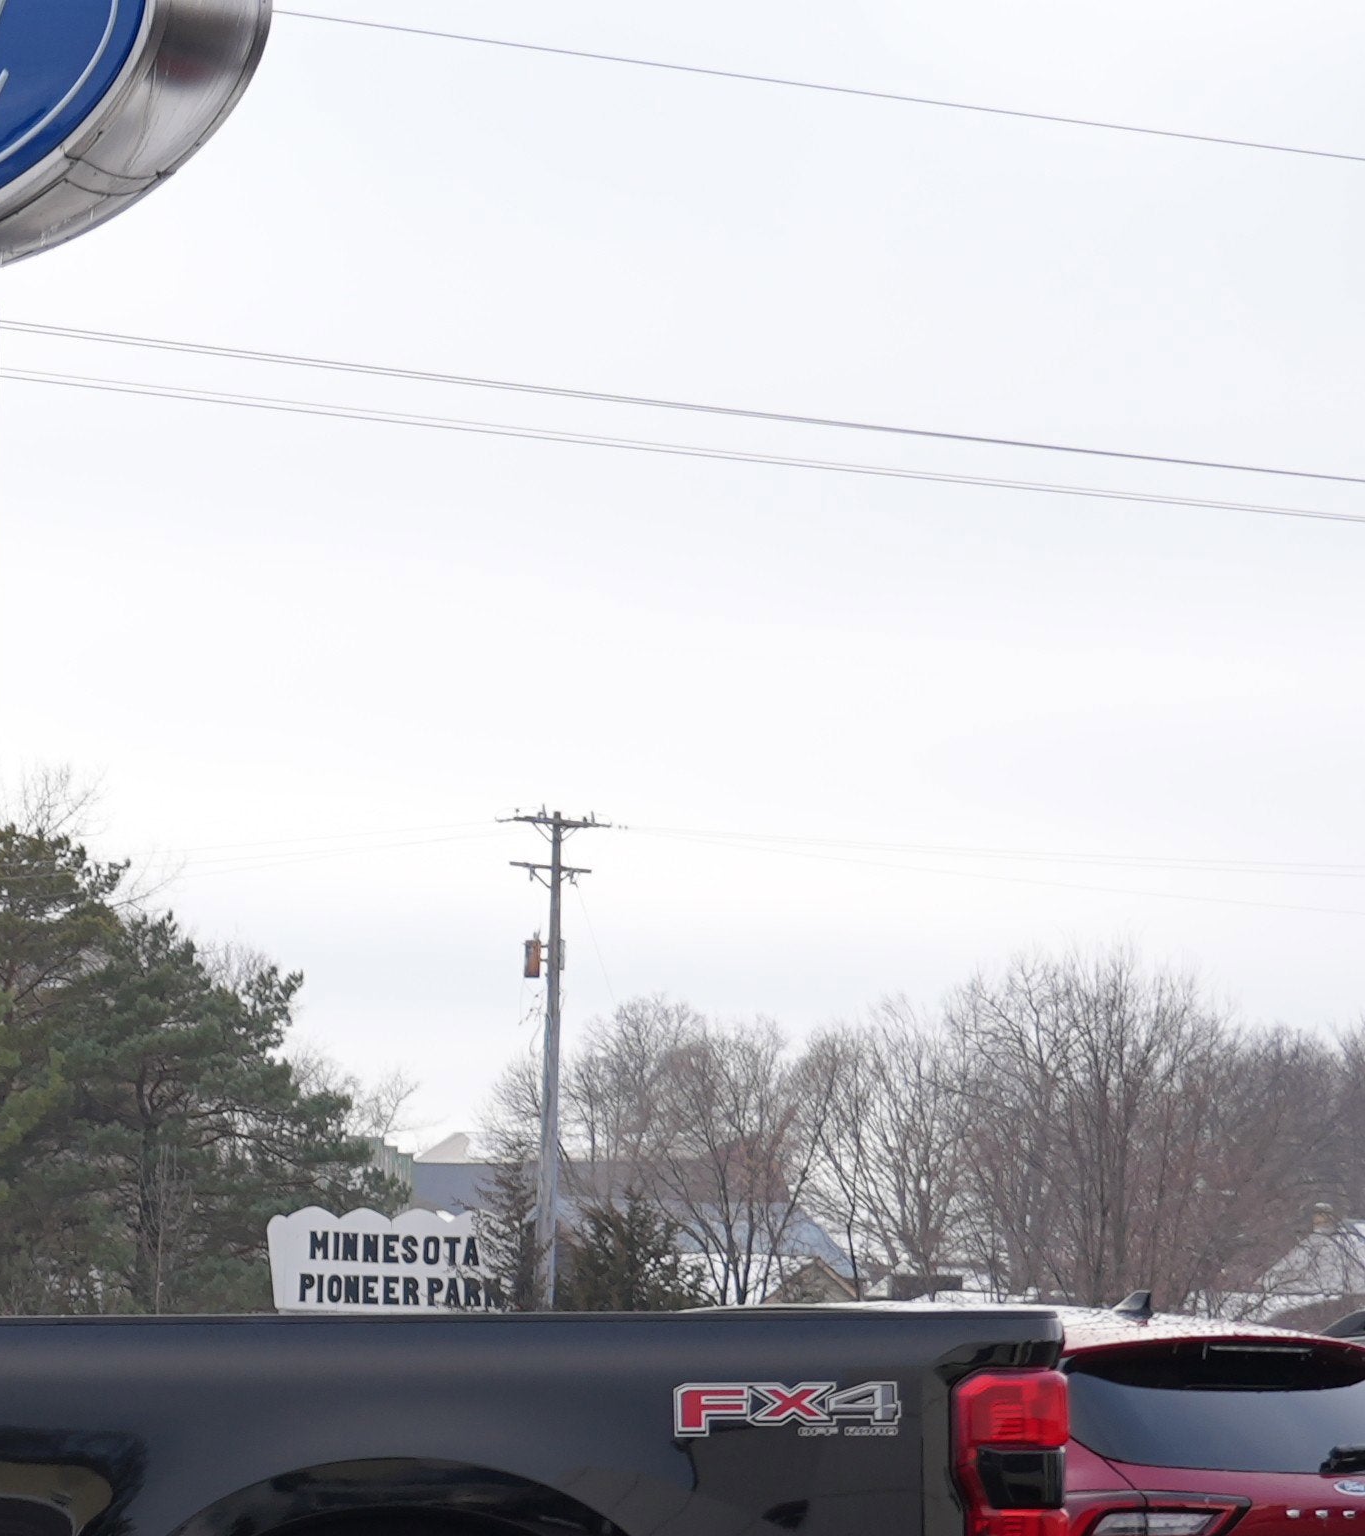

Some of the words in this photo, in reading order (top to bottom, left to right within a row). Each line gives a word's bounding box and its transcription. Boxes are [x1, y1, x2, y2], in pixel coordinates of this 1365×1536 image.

[308, 1230, 481, 1267] MINNESOTA
[298, 1272, 420, 1306] PIONEER
[673, 1381, 902, 1437] FX4
